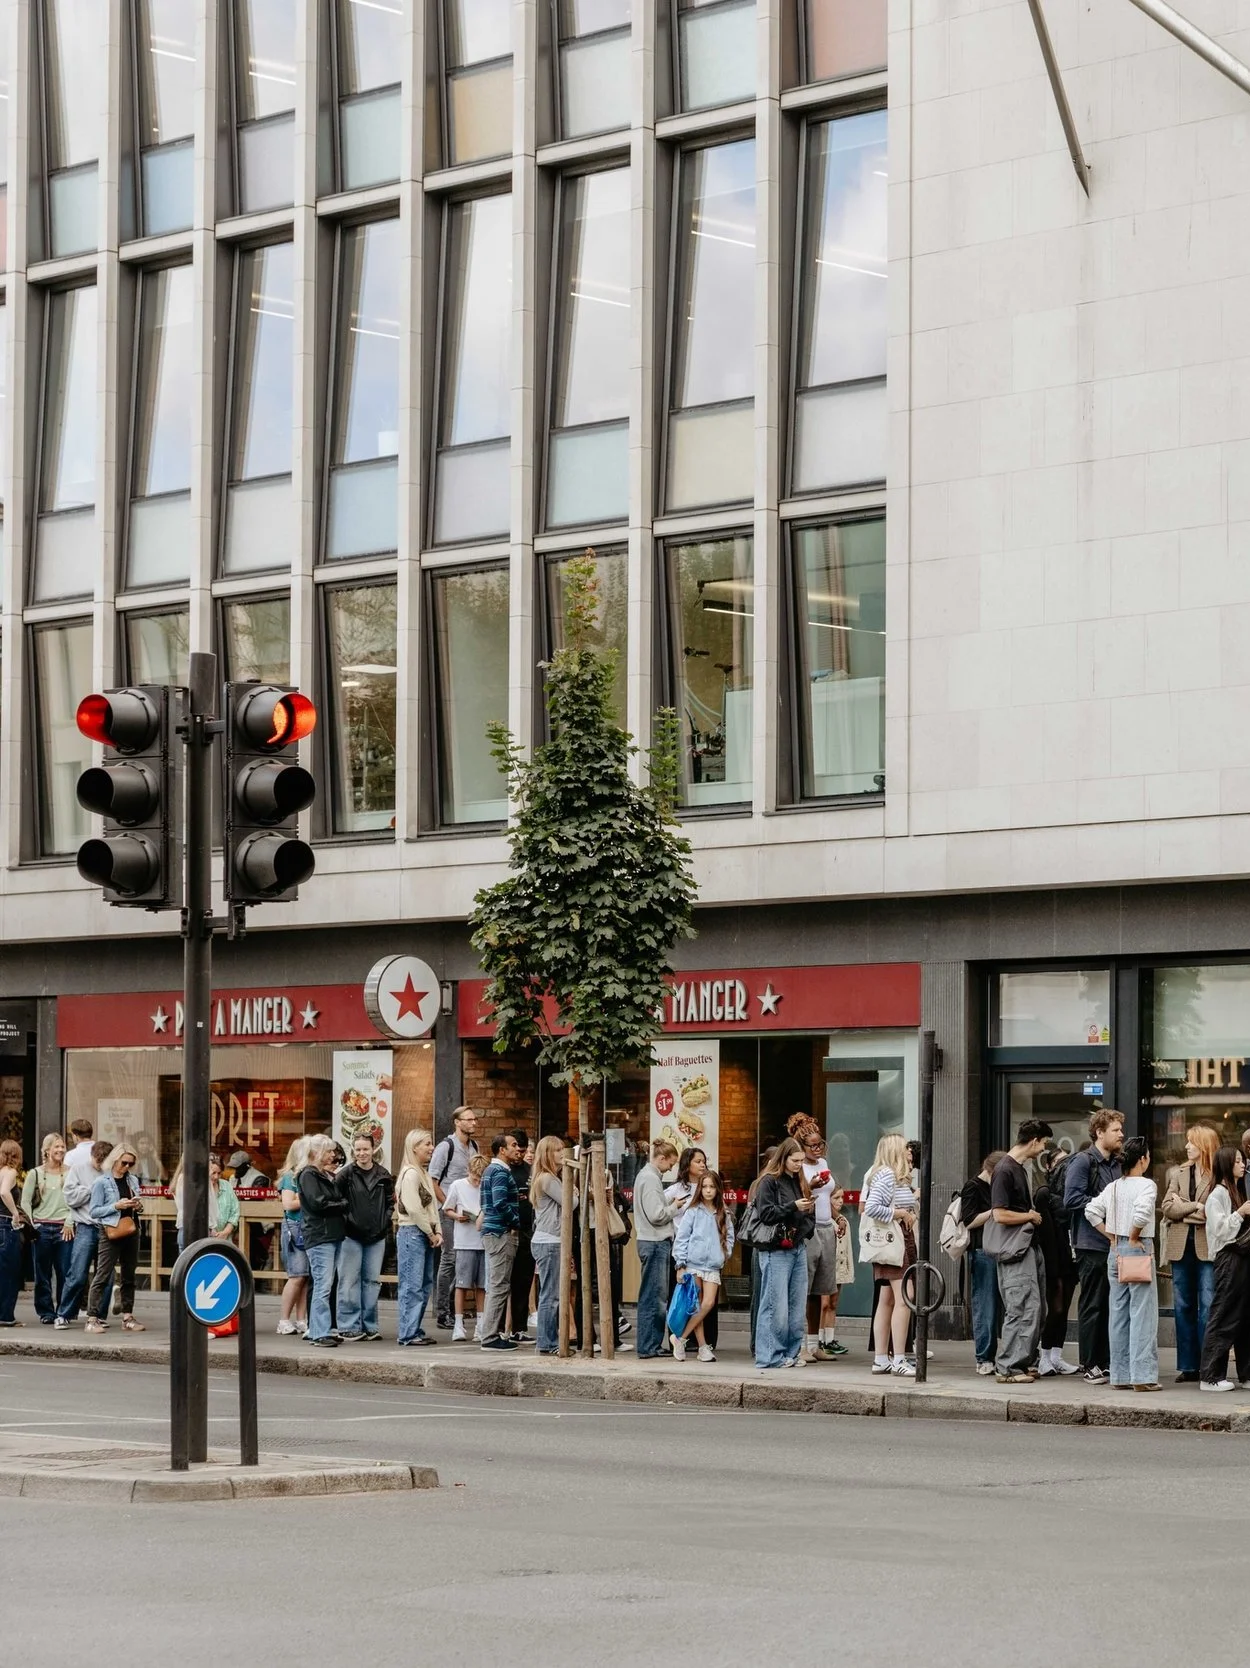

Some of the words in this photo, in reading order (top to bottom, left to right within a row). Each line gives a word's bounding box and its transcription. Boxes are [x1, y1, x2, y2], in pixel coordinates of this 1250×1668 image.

[672, 980, 748, 1022] MANGER
[215, 999, 227, 1036] A
[231, 997, 293, 1035] MANGER
[342, 1061, 369, 1071] Summer
[675, 1055, 713, 1068] Baguettes
[353, 1070, 375, 1080] Salads
[211, 1091, 279, 1147] PRET
[139, 1187, 156, 1195] SANTS
[722, 1192, 738, 1201] KIES
